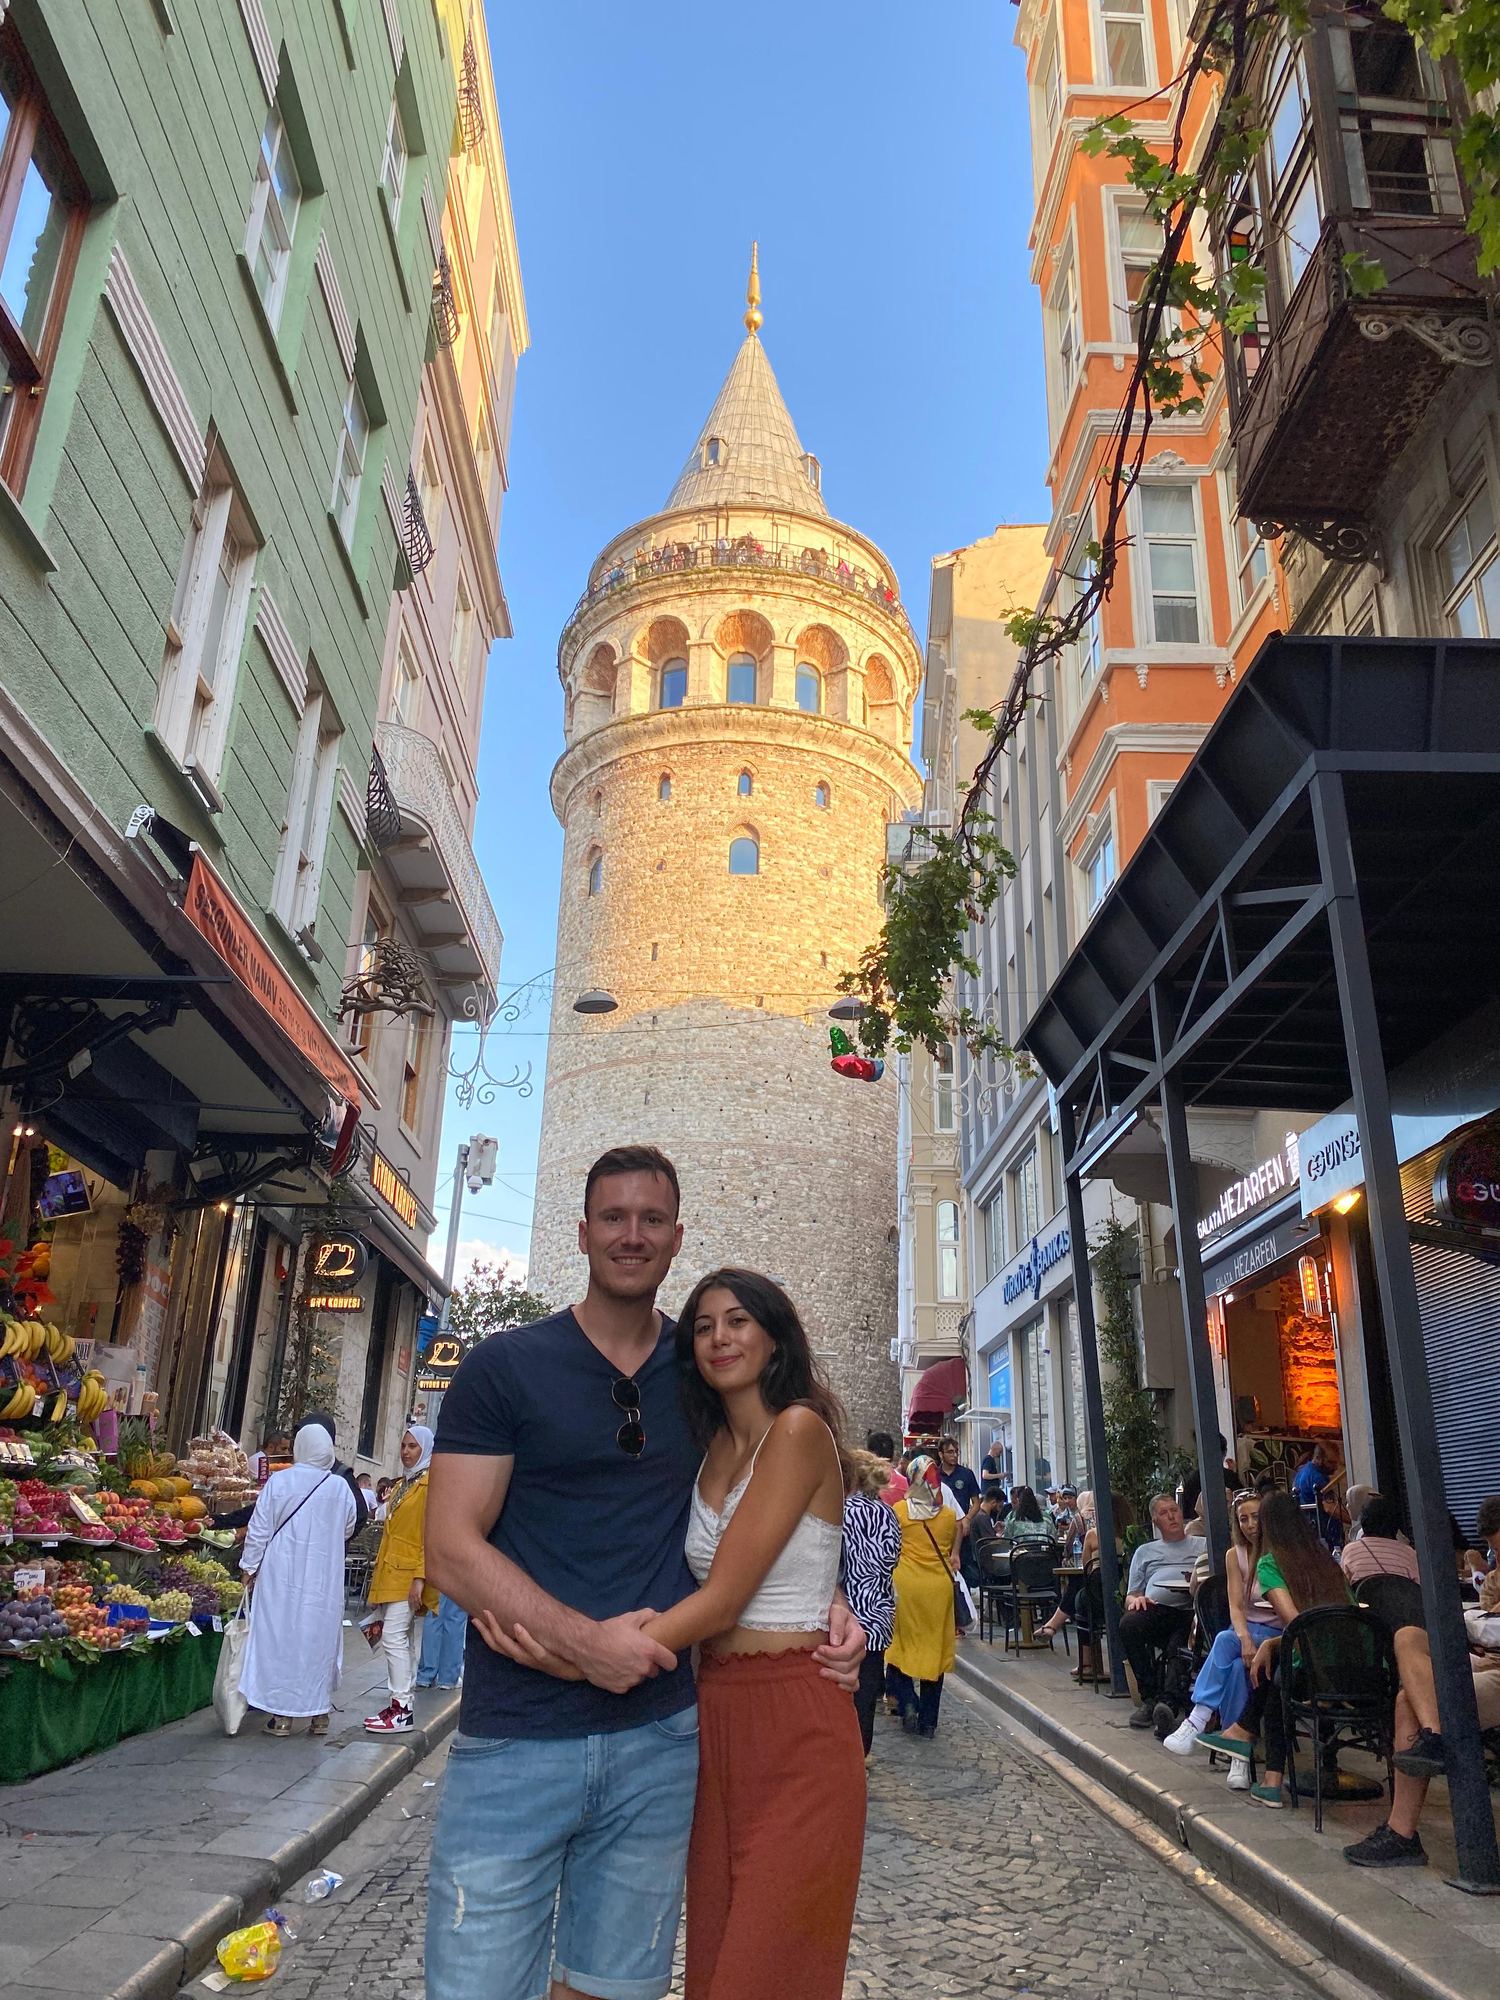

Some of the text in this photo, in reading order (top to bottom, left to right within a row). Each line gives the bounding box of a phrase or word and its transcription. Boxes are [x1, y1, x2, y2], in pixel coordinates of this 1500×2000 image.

[1197, 1153, 1285, 1239] GALATA HEZARFEN
[1215, 1235, 1277, 1290] GALATA HEZARFEN
